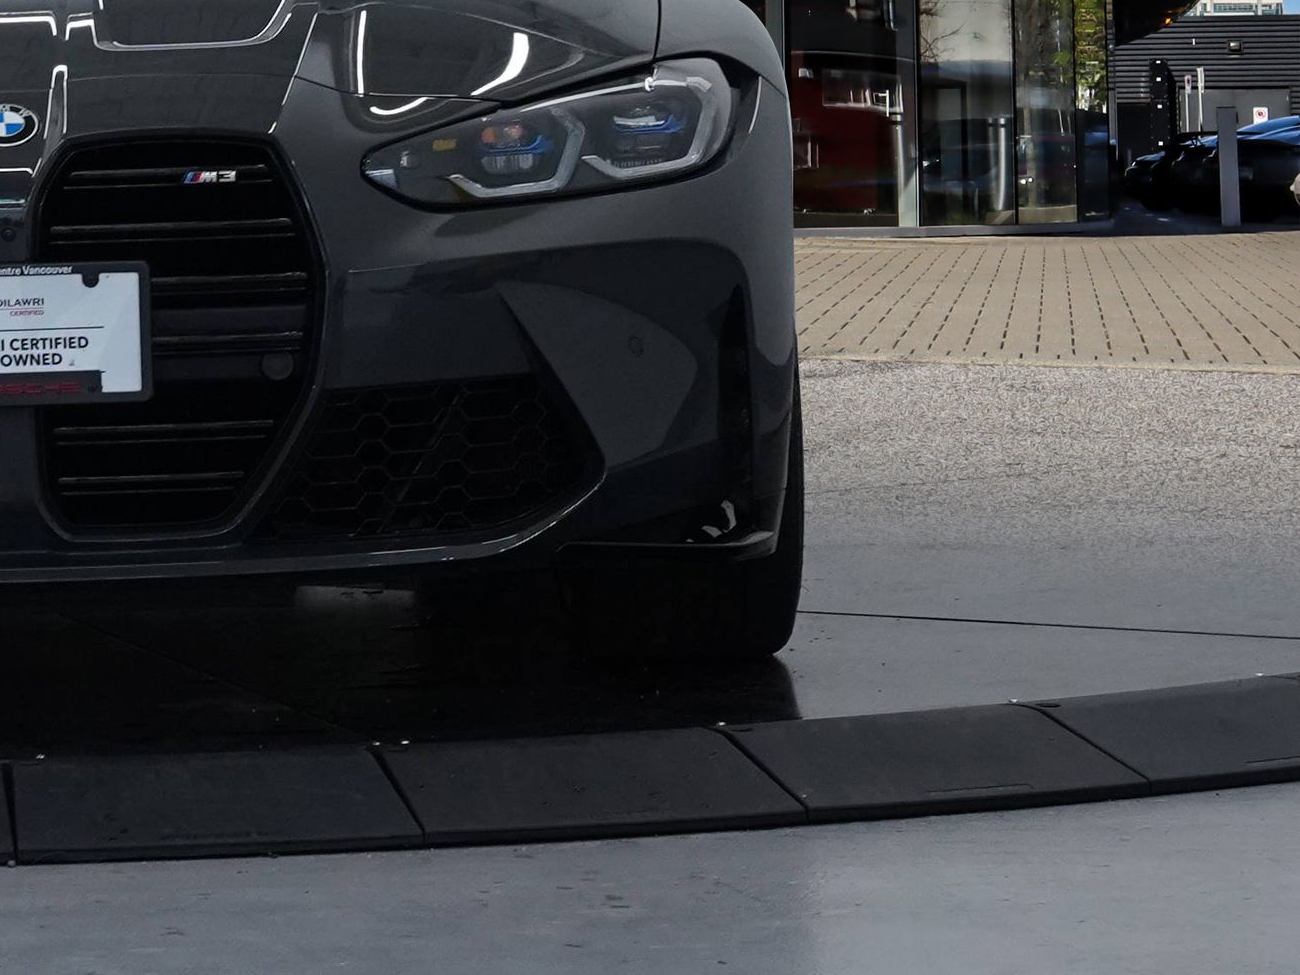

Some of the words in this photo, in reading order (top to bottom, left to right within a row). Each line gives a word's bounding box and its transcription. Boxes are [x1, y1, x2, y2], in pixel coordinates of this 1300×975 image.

[195, 170, 236, 183] M3
[21, 265, 73, 275] Vancouver
[9, 309, 45, 317] CERTIFIED
[9, 336, 90, 352] CERTIFIED
